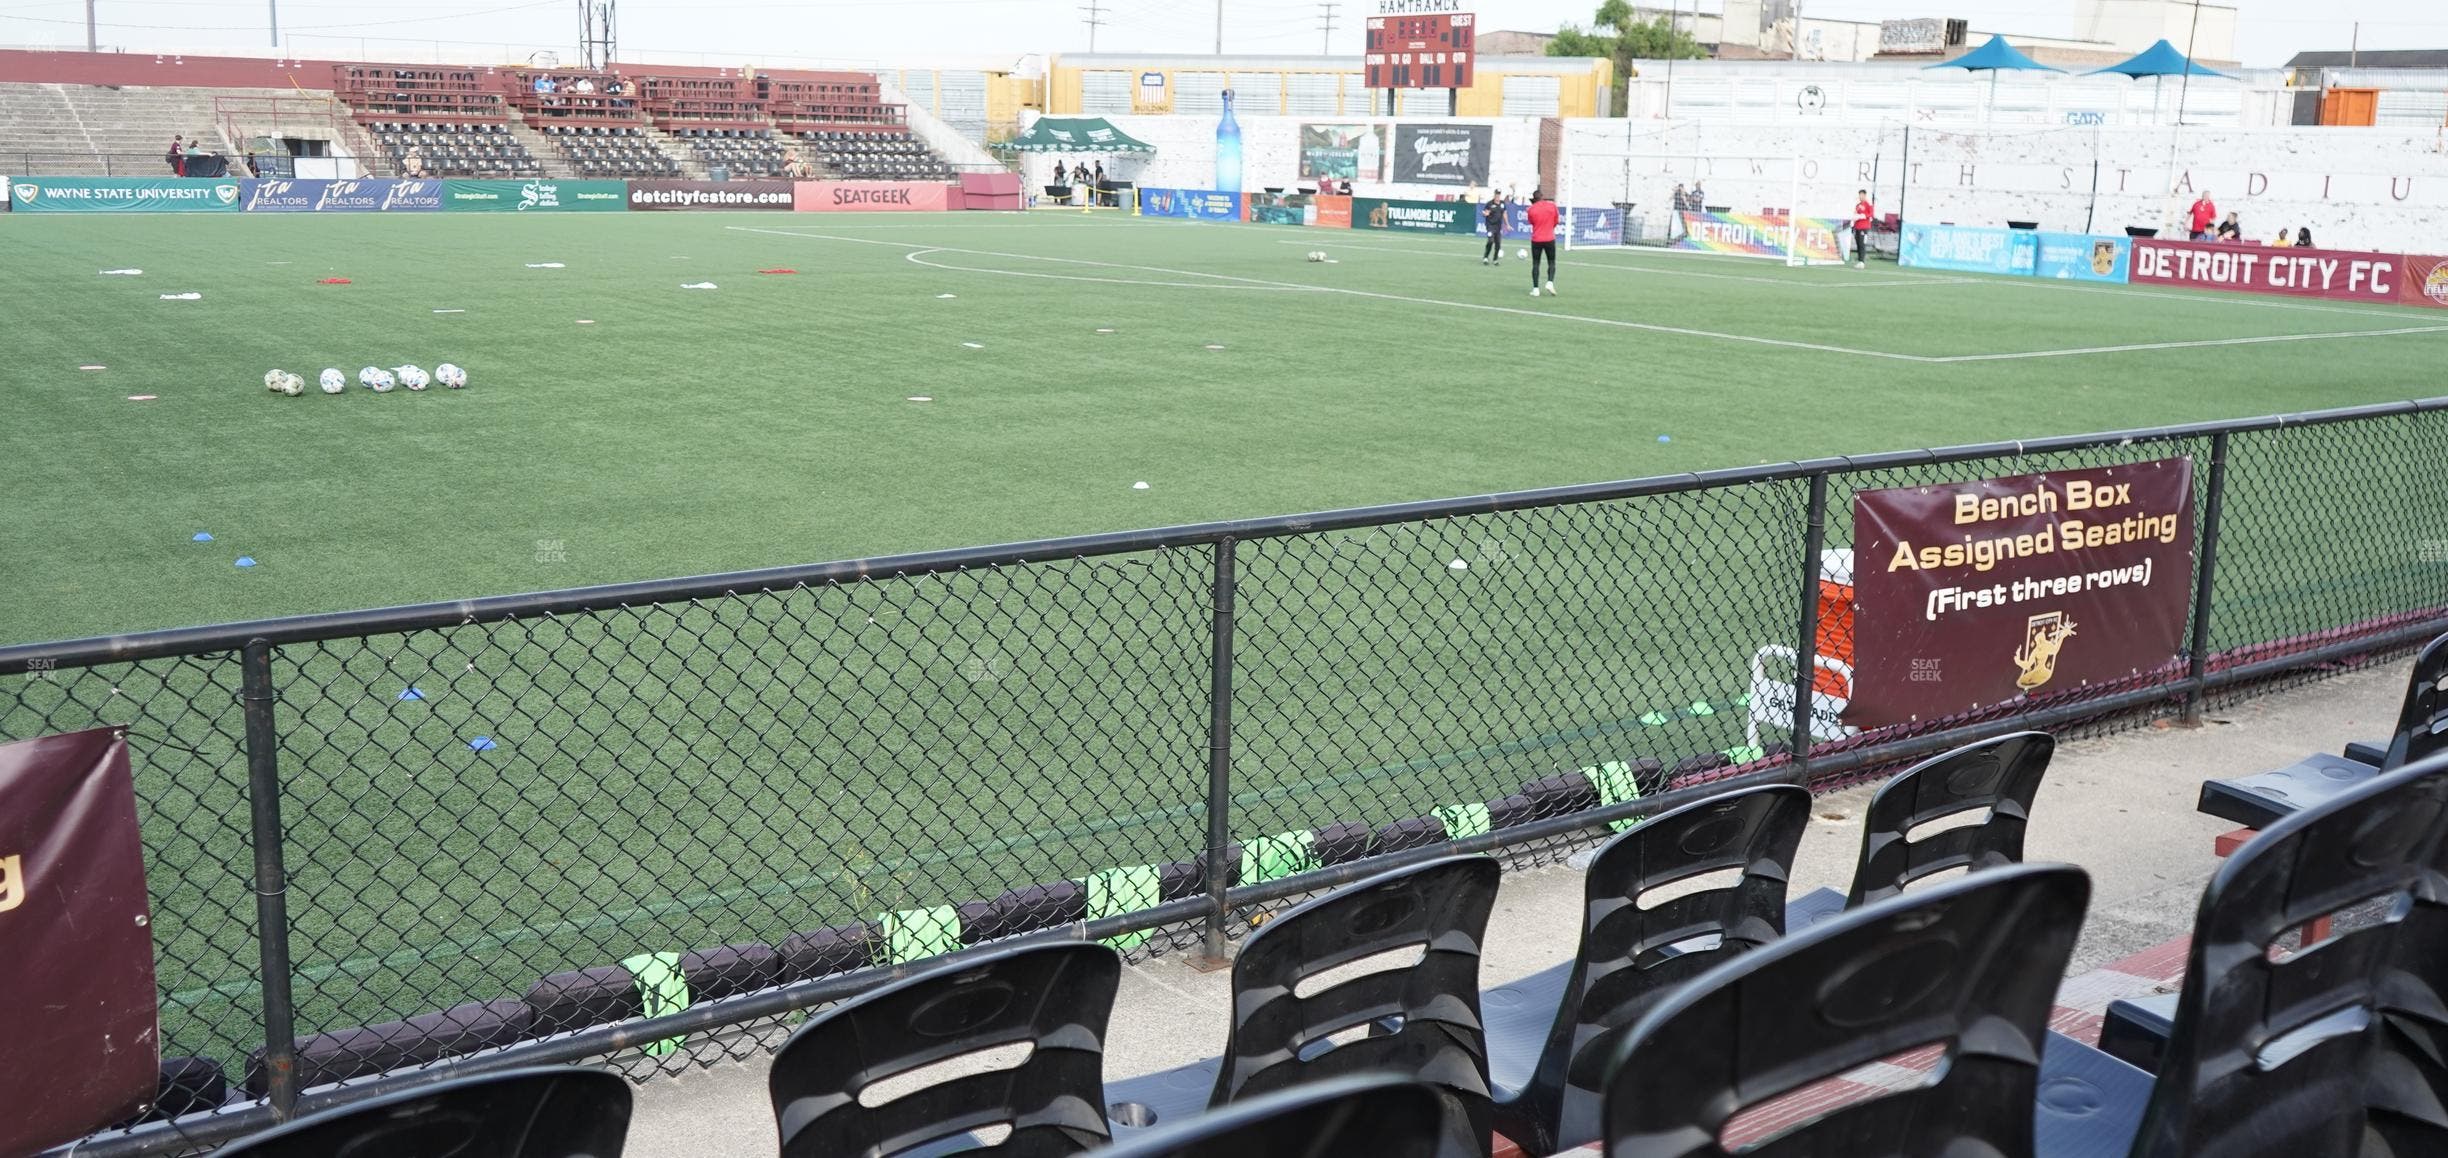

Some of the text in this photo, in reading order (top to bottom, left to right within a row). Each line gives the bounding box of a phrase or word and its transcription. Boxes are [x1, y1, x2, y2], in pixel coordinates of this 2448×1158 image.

[45, 188, 211, 199] WAYNE STATE UNIVERSITY
[257, 197, 308, 205] REALTORS
[325, 197, 375, 205] REALTORS
[391, 197, 439, 205] REALTORS
[632, 190, 792, 205] detcityfcstore.com
[833, 188, 912, 205] SEATGEEK
[1388, 207, 1432, 221] TULLAMORE
[1691, 221, 1759, 245] DETROIT
[1806, 228, 1829, 249] FC
[2138, 246, 2392, 294] DETROIT CITY FC
[1955, 480, 2131, 525] Bench Box
[1887, 512, 2178, 573] Assigned Seating
[1926, 557, 2153, 621] (First three rows)
